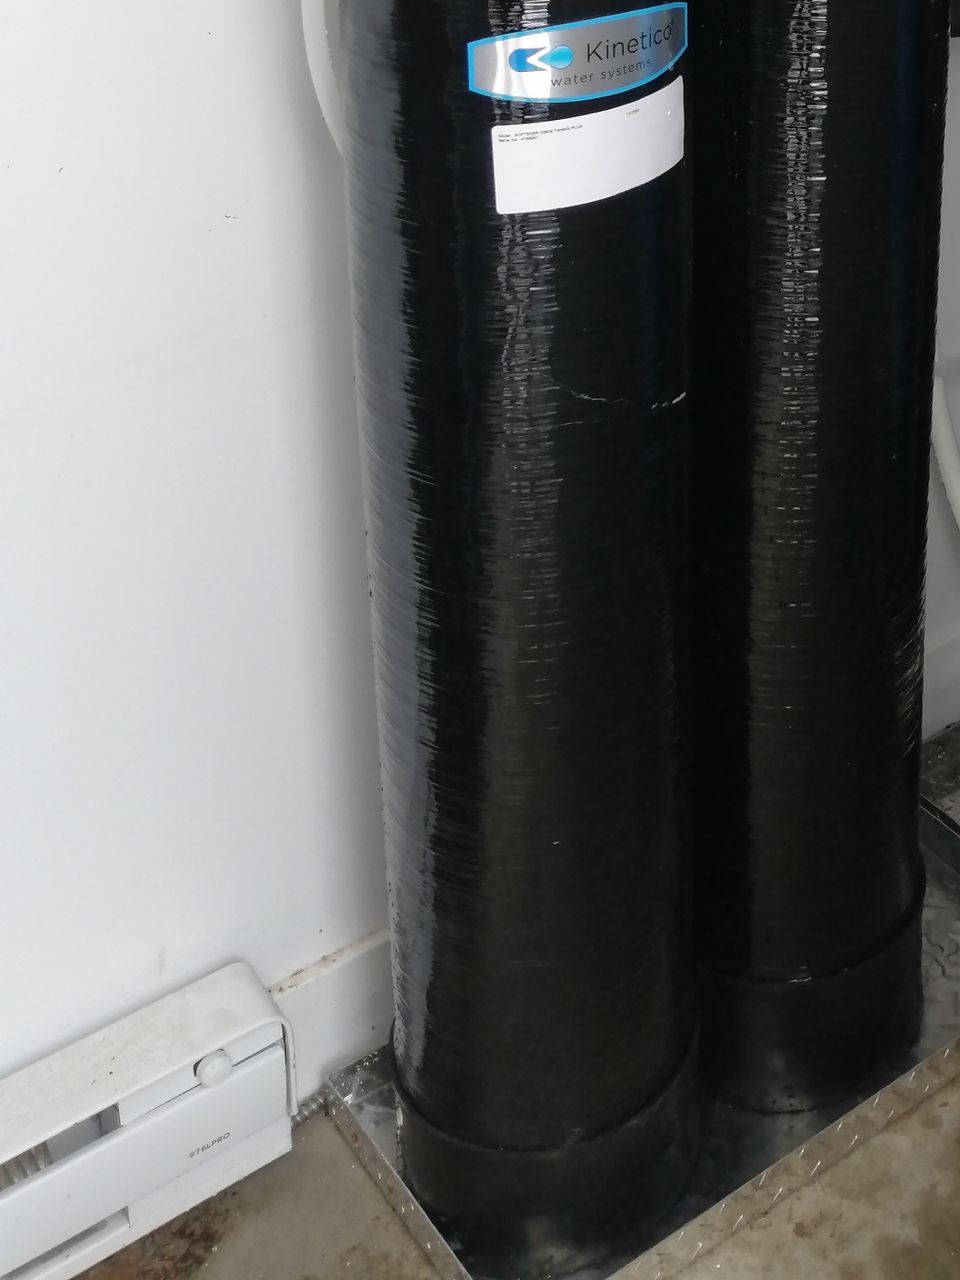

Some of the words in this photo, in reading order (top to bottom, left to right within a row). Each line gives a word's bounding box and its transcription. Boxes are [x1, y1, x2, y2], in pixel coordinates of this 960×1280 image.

[586, 24, 672, 63] Kinetico
[551, 73, 595, 87] water
[601, 58, 652, 80] systems
[189, 1132, 231, 1159] STELPRO
